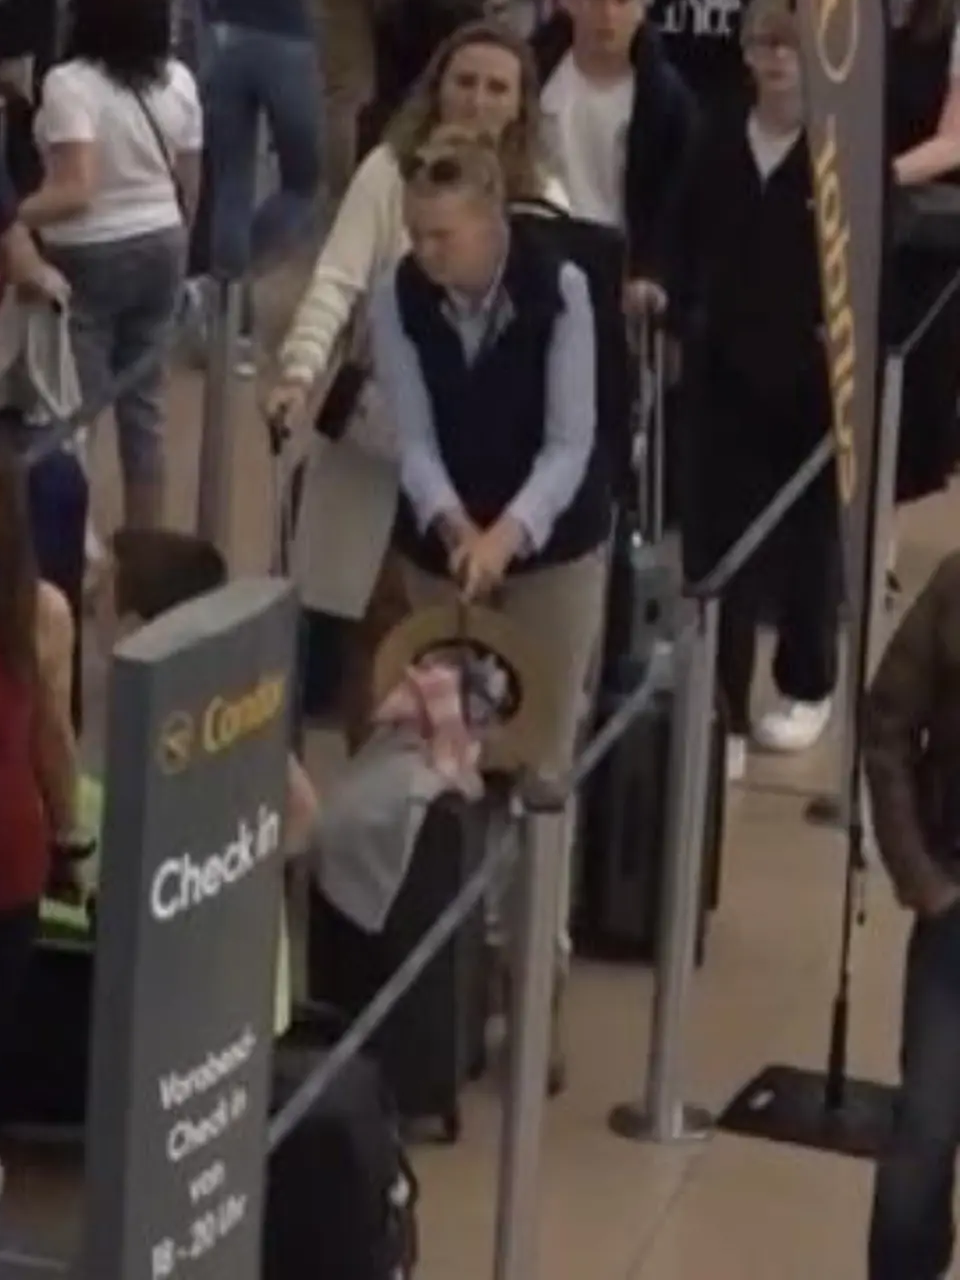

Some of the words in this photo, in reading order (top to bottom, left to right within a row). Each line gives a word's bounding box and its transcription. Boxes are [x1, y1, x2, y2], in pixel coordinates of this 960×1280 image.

[150, 821, 253, 918] Check
[255, 806, 279, 858] in
[168, 1098, 228, 1161] Check
